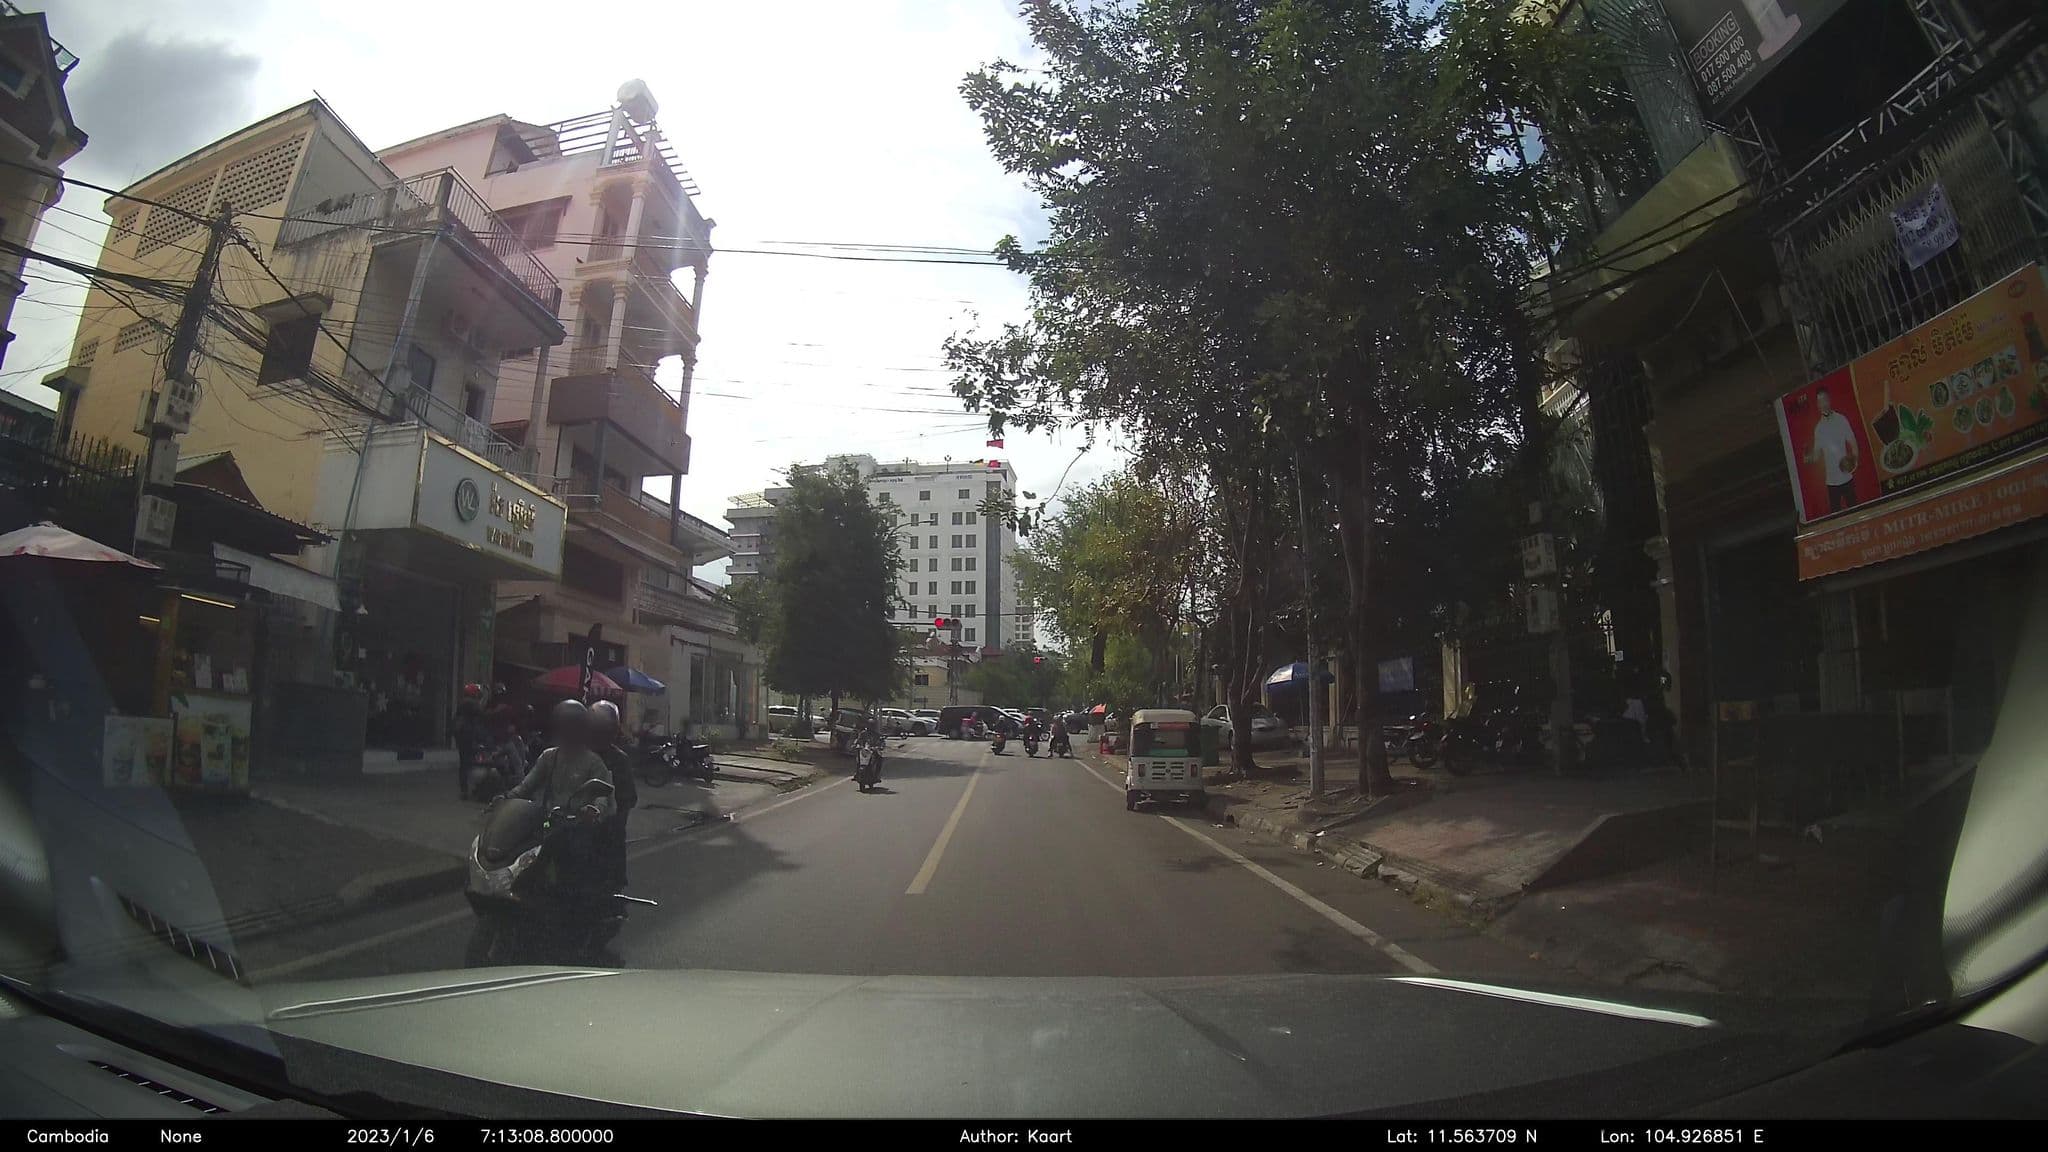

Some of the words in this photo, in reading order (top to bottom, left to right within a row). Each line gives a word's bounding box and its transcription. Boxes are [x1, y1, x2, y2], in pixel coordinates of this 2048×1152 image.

[1693, 18, 1736, 65] BOOKING
[1701, 62, 1715, 82] 017
[1715, 50, 1730, 69] 500
[1730, 36, 1745, 54] 400
[1707, 76, 1721, 96] 087
[1722, 64, 1737, 83] 500
[1737, 50, 1752, 68] 400
